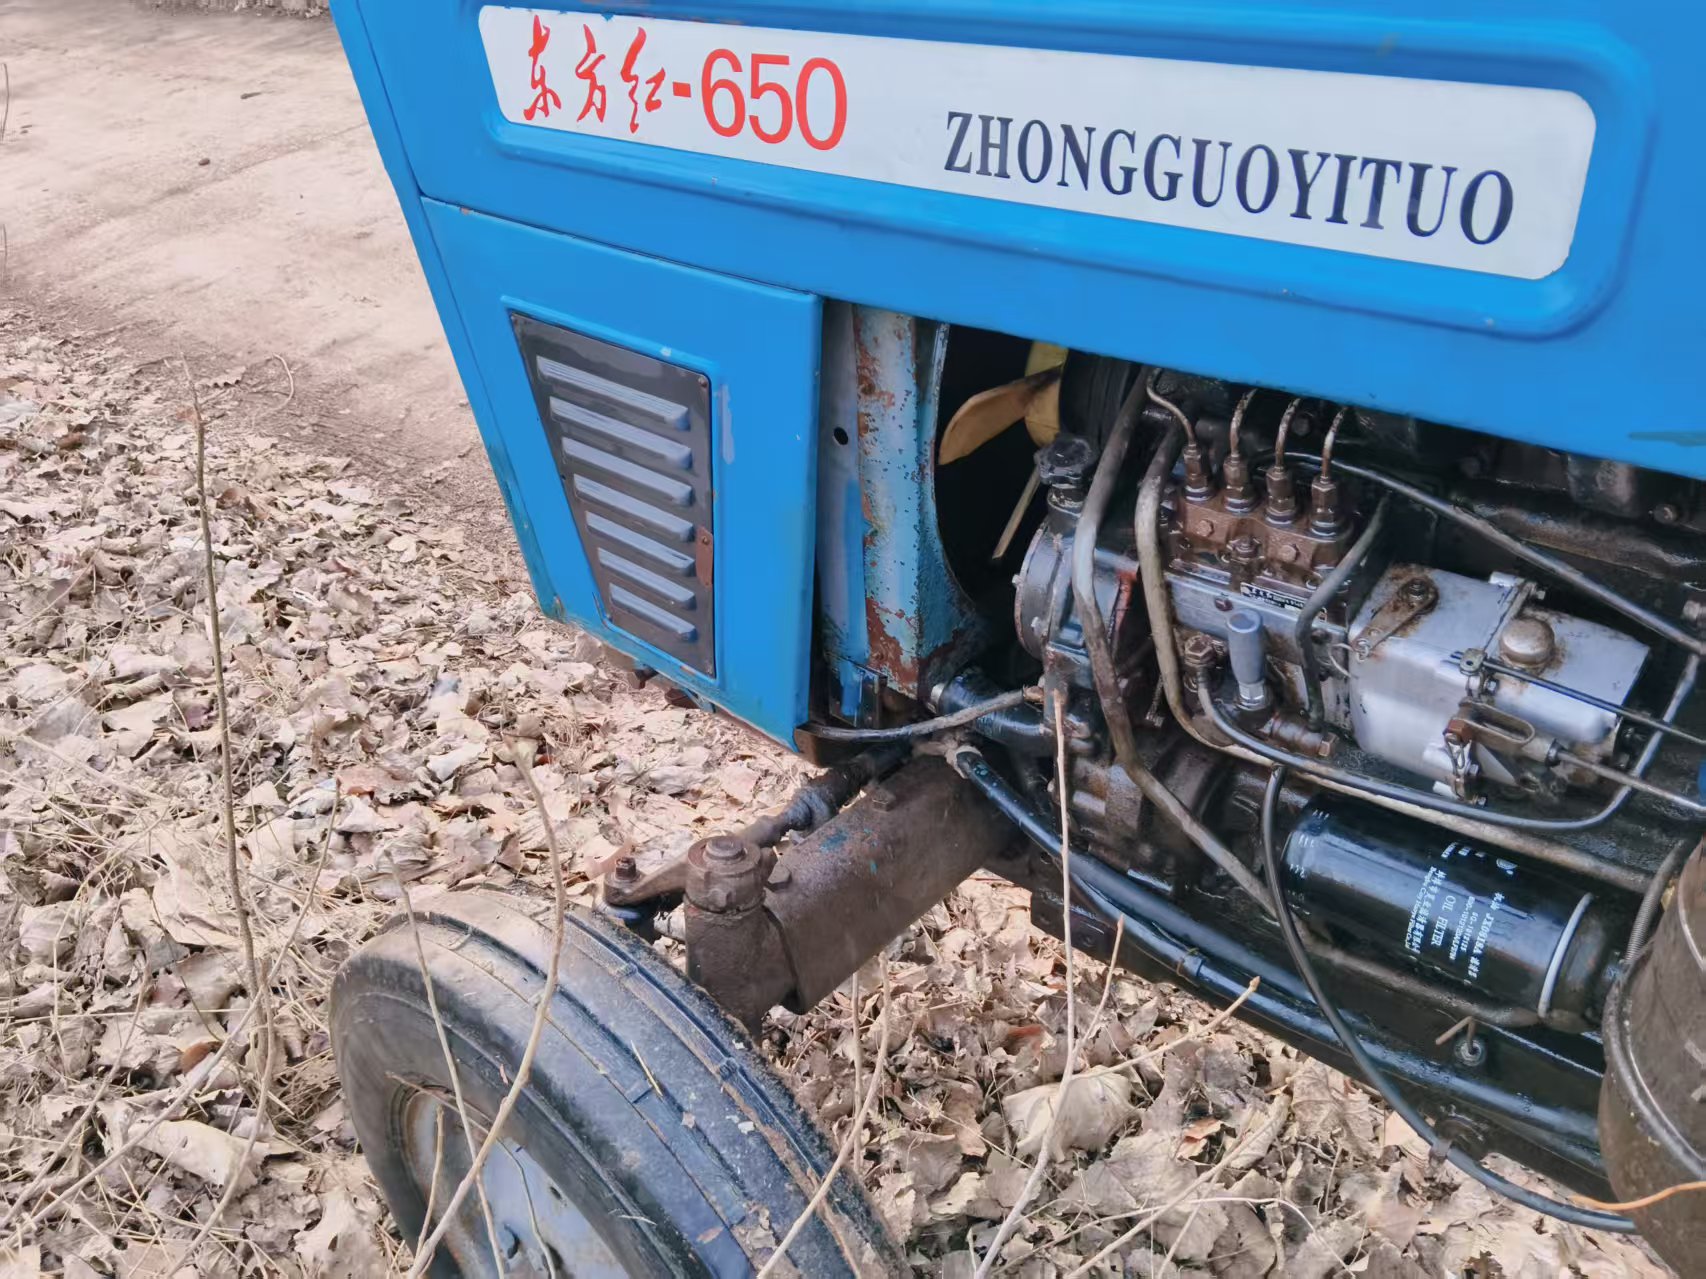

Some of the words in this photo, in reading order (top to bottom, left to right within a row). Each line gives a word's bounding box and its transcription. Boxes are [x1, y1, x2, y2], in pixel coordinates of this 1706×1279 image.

[523, 14, 848, 151] 东方红-650
[945, 111, 1514, 246] ZHONGGUOYITUO
[1430, 916, 1448, 946] FILTER
[1441, 894, 1456, 913] OIL
